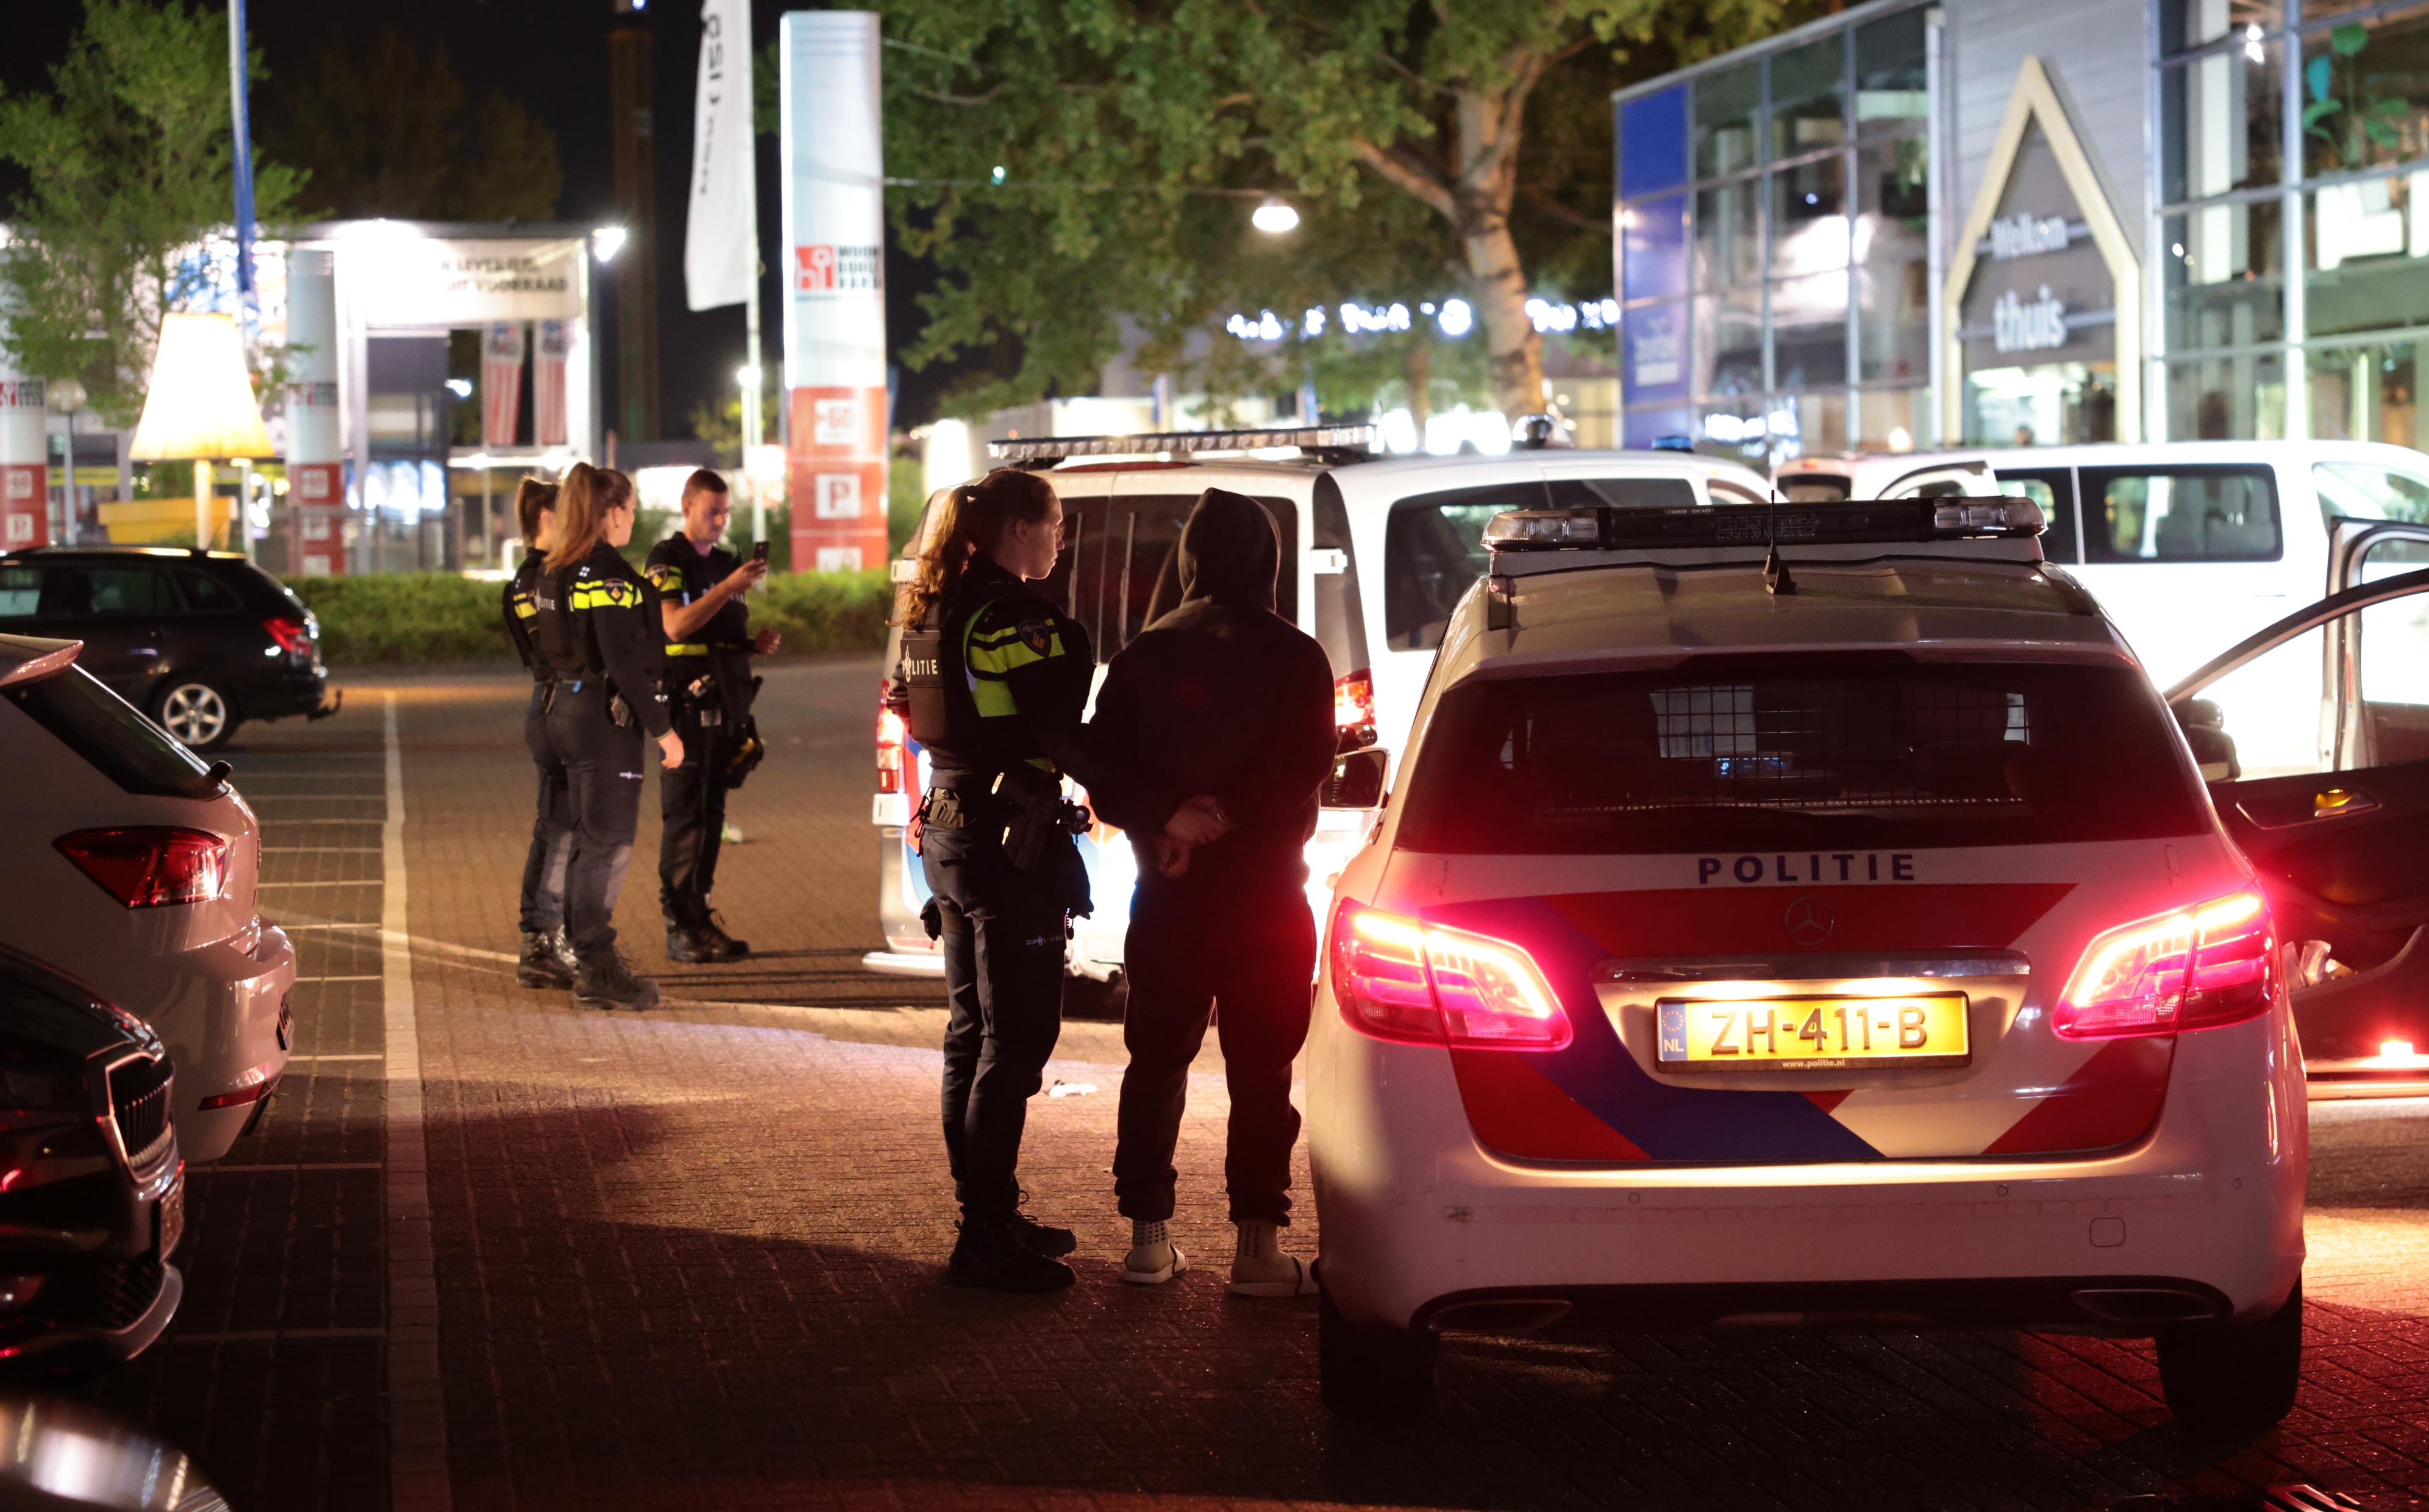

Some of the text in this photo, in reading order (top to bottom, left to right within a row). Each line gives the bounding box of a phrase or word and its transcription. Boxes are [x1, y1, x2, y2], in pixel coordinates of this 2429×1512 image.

[1992, 283, 2067, 353] thuis
[1698, 854, 1915, 885] POLITIE
[1664, 1038, 1684, 1053] NL
[1711, 1006, 1928, 1055] ZH-411-B
[1782, 1058, 1846, 1069] www.politie.nl
